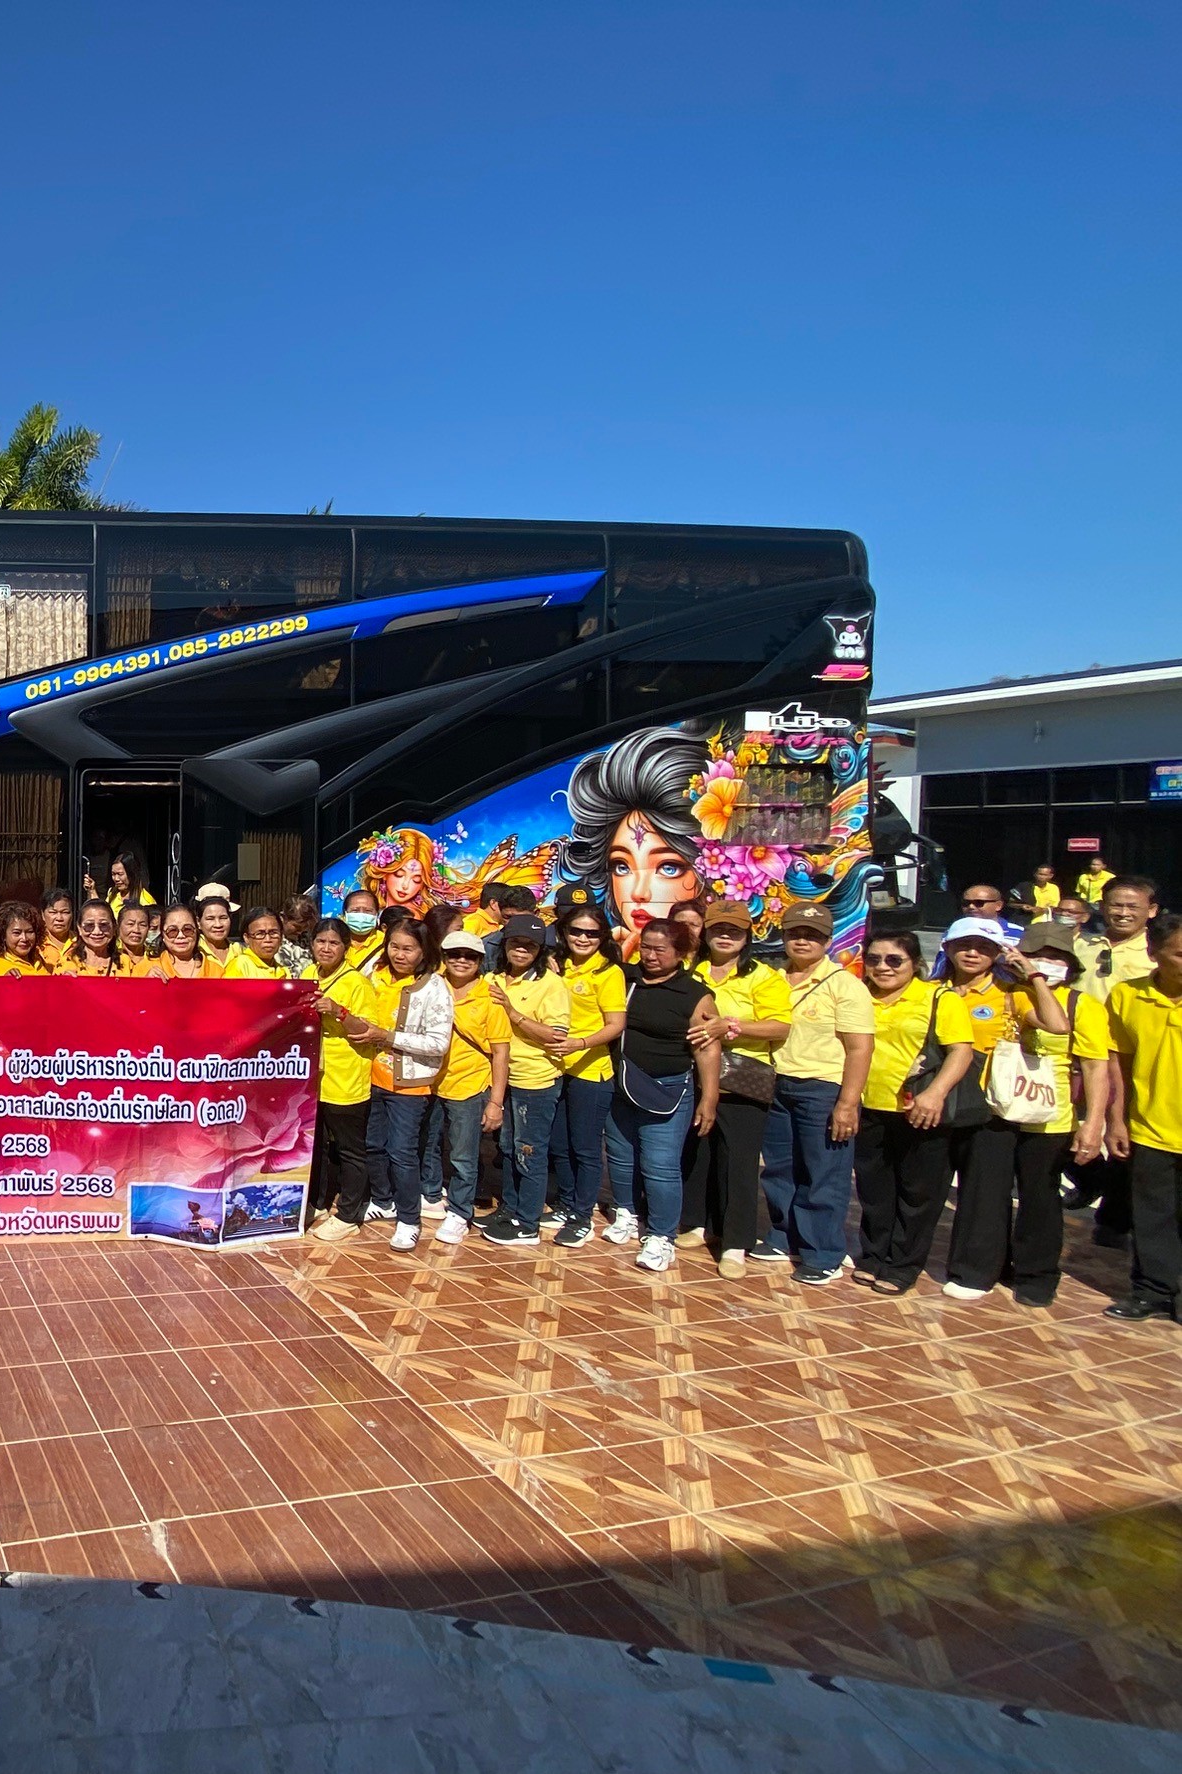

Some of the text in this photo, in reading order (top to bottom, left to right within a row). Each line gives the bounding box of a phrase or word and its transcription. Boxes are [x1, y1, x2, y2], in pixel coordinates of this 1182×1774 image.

[8, 1046, 172, 1082] ผู้ช่วยผู้บริหารท้องถิ่น
[4, 1137, 48, 1154] 2568
[63, 1177, 113, 1193] 2568
